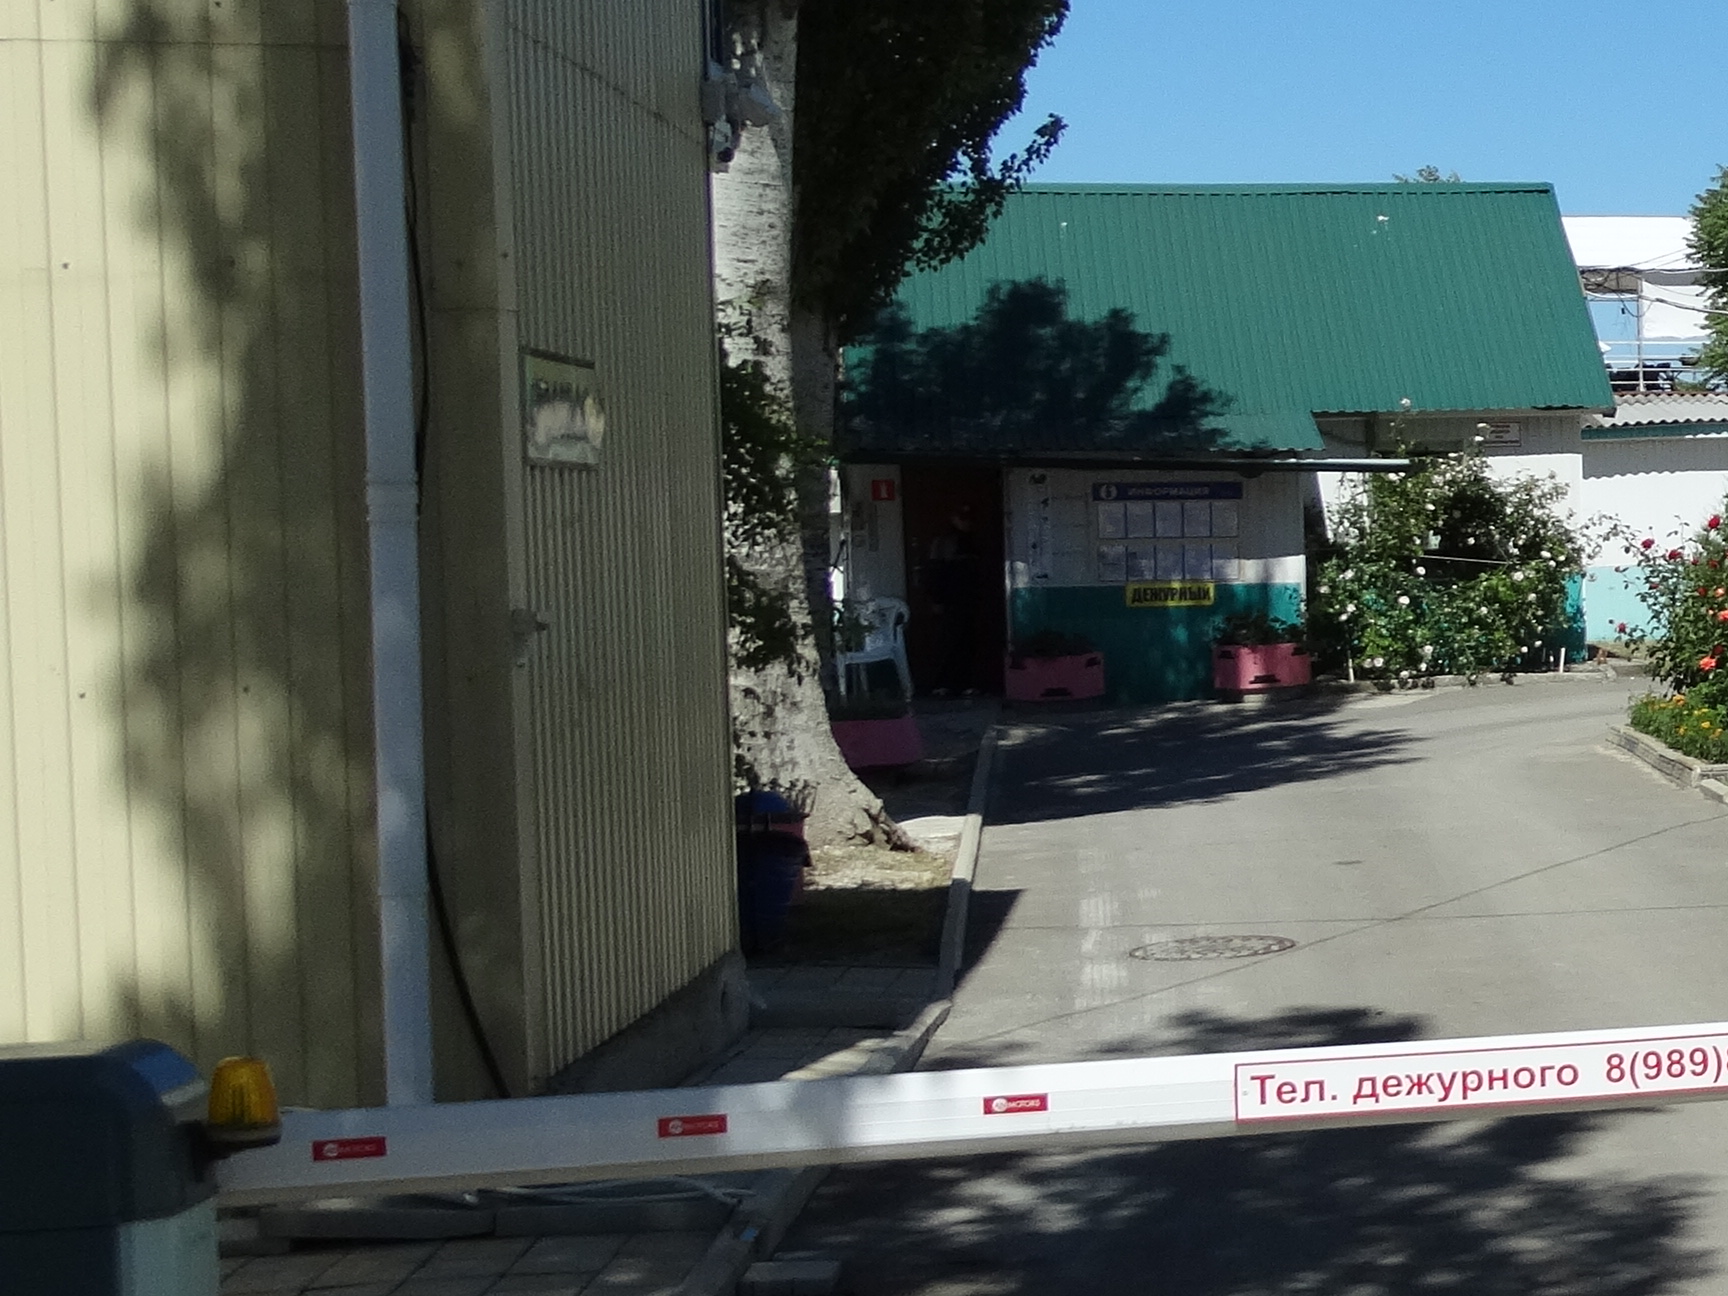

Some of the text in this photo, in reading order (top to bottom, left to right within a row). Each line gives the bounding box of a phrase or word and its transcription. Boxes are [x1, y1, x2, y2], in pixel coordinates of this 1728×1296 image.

[1127, 486, 1210, 497] ИНФОРМАЦИЯ
[1249, 1073, 1339, 1106] Тел.
[1352, 1062, 1580, 1105] дежурного
